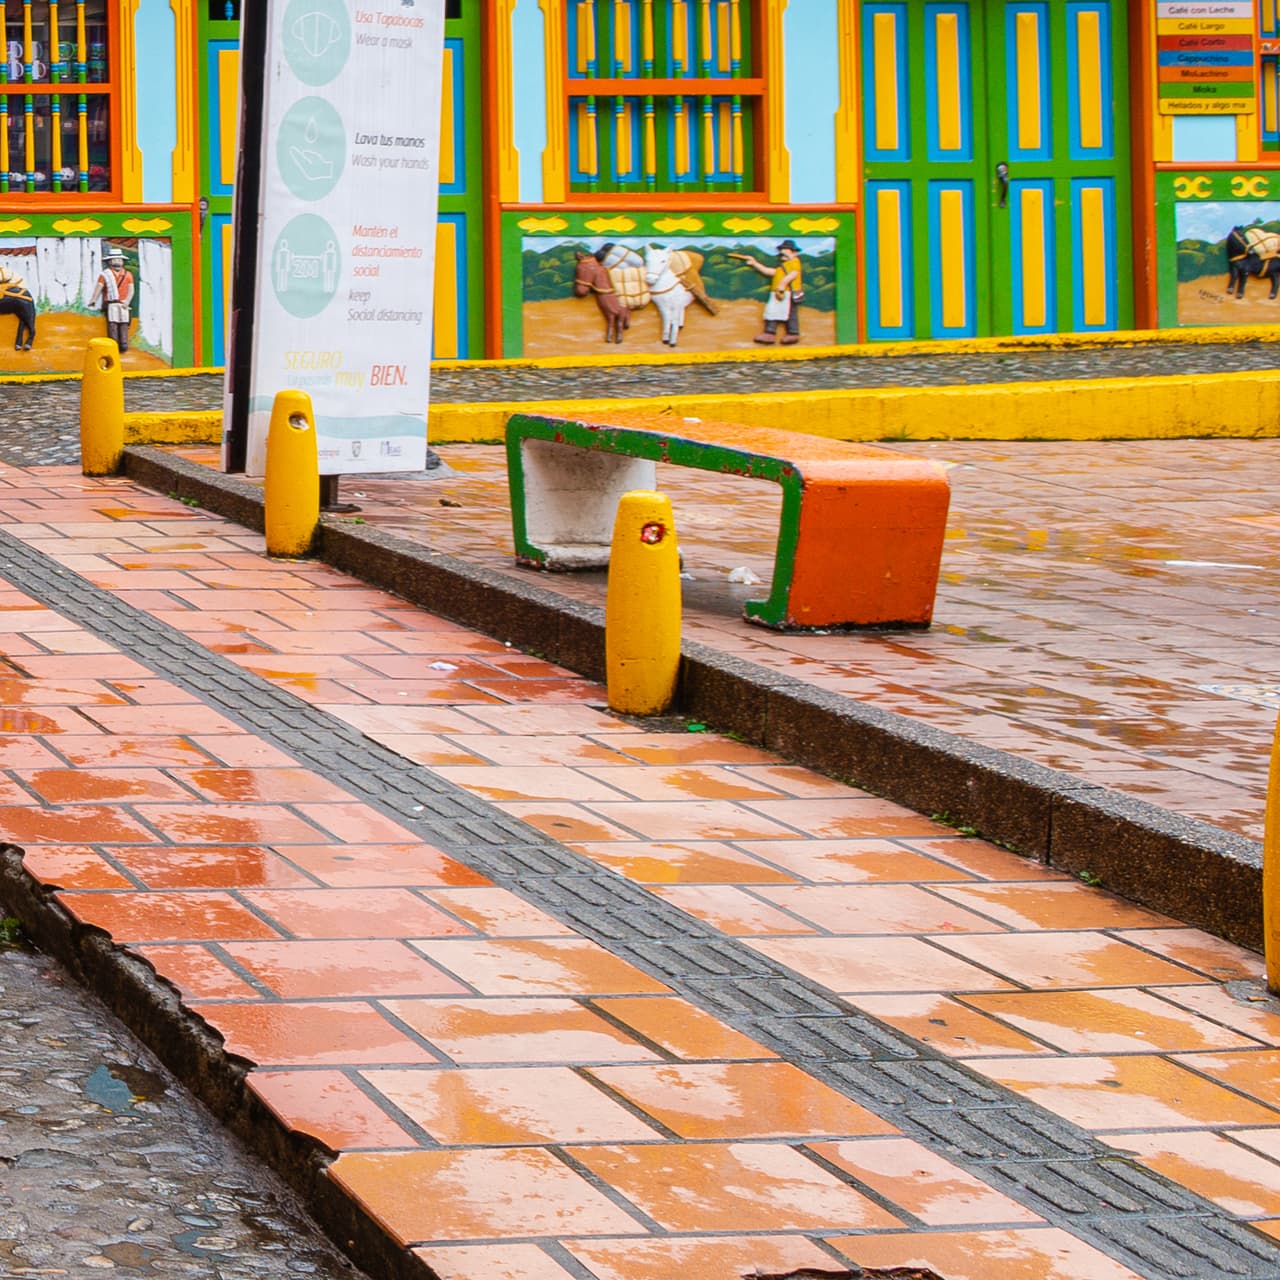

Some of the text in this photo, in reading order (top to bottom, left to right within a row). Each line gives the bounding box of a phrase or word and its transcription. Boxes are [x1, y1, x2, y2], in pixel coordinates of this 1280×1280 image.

[1209, 6, 1235, 14] Leche
[356, 10, 424, 29] Usa Tapabocas
[1200, 23, 1225, 31] Largo
[356, 34, 413, 48] Wear a mask
[1193, 85, 1217, 93] Moka
[355, 132, 425, 148] Lava tus manos
[352, 154, 430, 171] Wash your hands
[352, 225, 398, 238] Mantén el
[352, 245, 423, 258] distanciamiento
[353, 265, 380, 277] social
[348, 288, 371, 304] keep
[347, 308, 423, 325] Social distancing
[283, 351, 343, 370] SEGURO
[335, 371, 366, 392] muy
[370, 365, 408, 387] BIEN.
